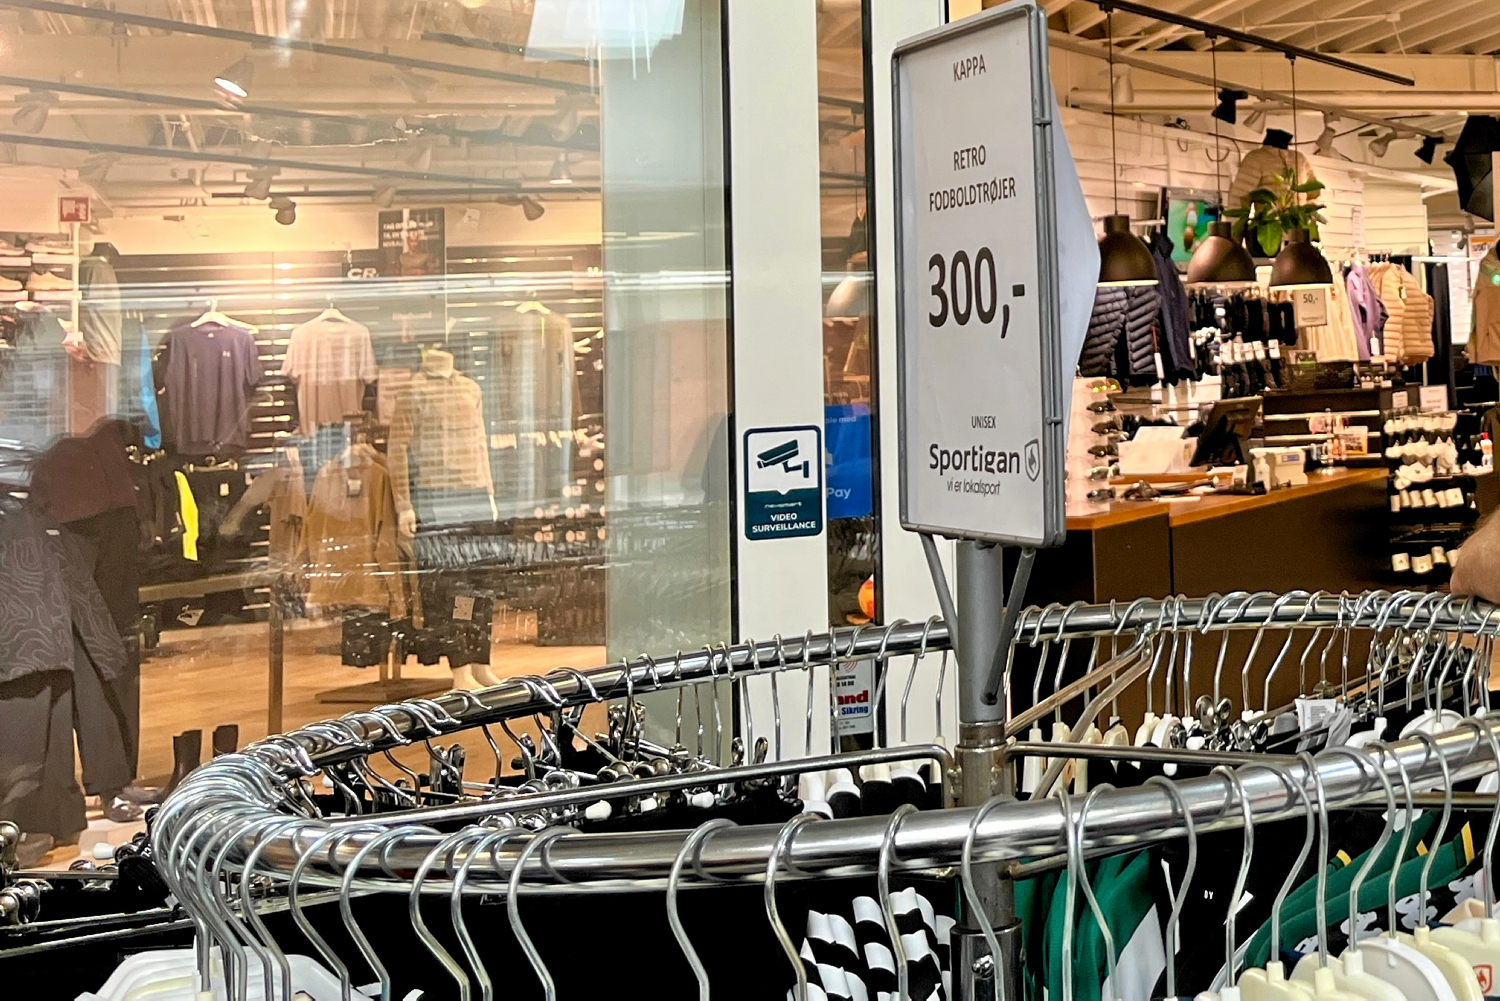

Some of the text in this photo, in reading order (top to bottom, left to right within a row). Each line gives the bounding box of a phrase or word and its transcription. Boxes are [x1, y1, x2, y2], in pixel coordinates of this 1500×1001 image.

[952, 53, 987, 82] KAPPA
[953, 144, 987, 172] RETRO
[929, 176, 1017, 213] FODBOLDTRØJER
[928, 246, 1026, 340] 300,-
[971, 415, 997, 429] UNISEX
[929, 443, 1020, 477] Sportigan
[963, 478, 1001, 498] lokalsport
[752, 520, 817, 534] SURVEILLANCE
[770, 512, 798, 522] VIDEO
[841, 706, 869, 716] Sikring
